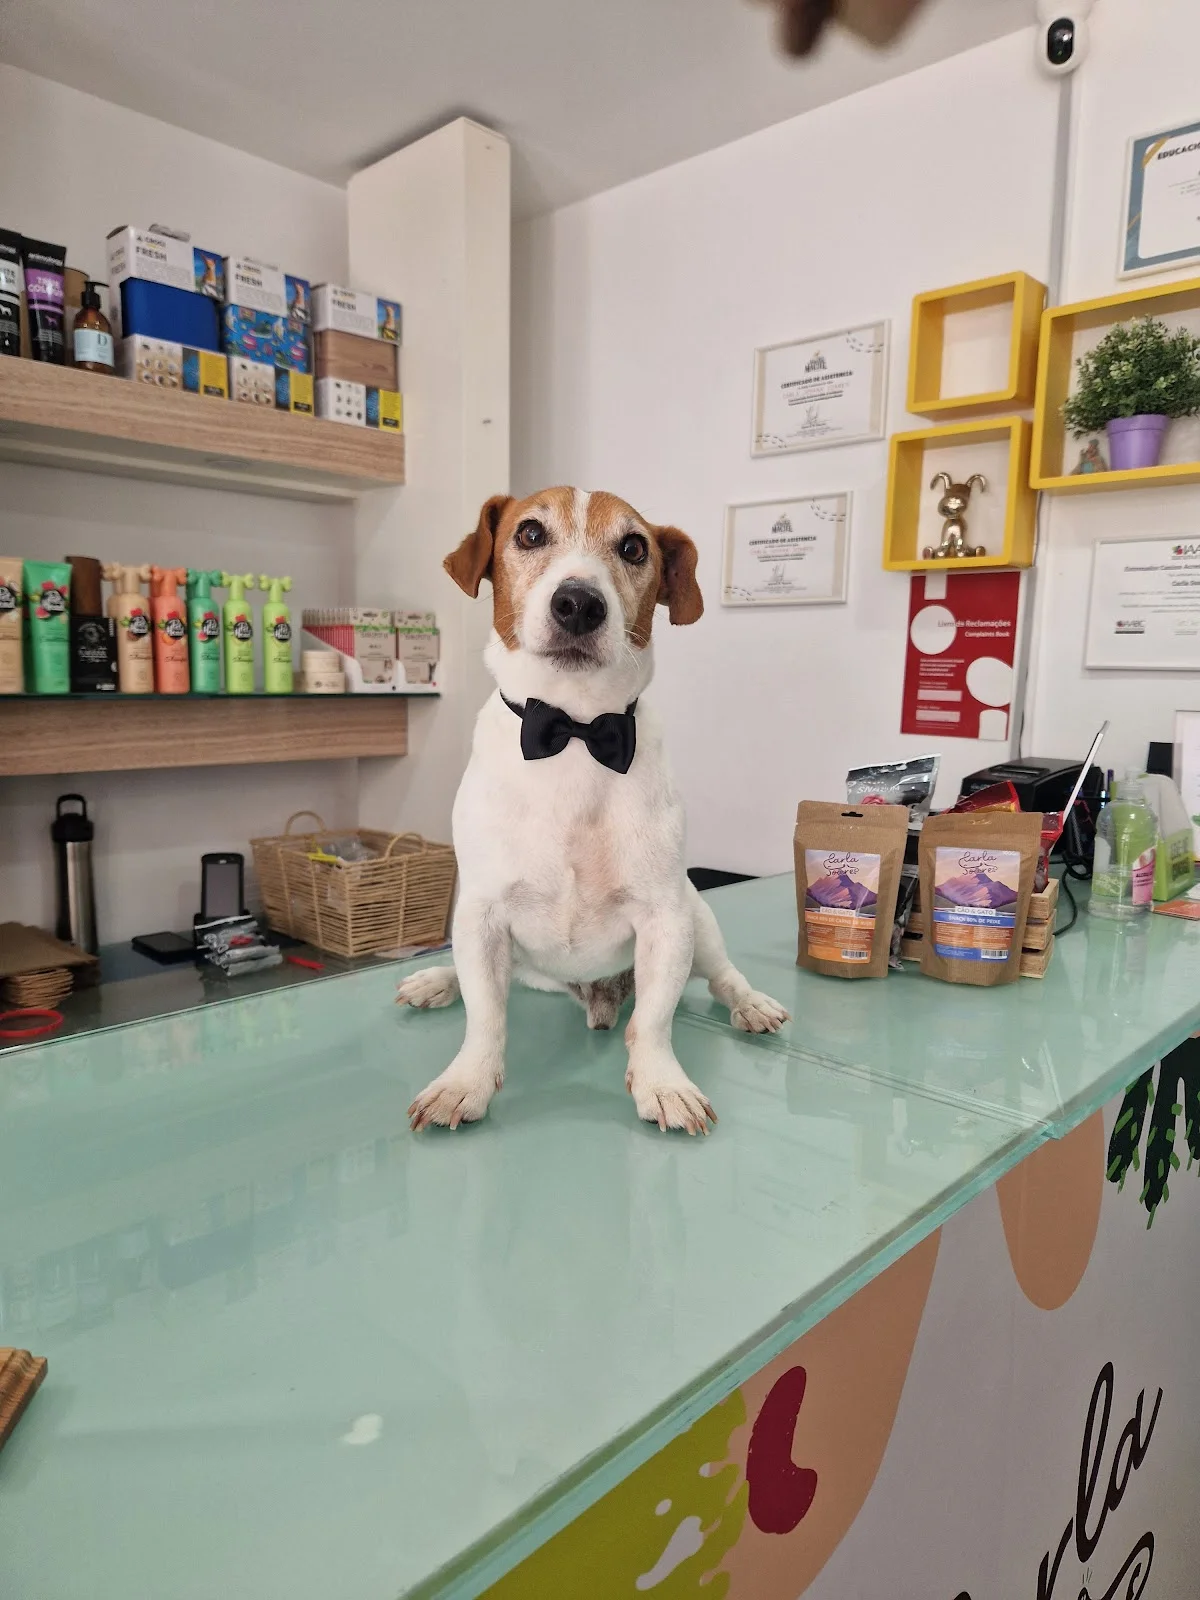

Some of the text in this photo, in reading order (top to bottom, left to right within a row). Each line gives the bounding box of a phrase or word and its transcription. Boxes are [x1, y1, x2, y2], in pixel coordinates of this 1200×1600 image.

[137, 247, 167, 262] FRESH
[956, 619, 965, 627] de
[966, 619, 1011, 629] Reclamações
[965, 630, 1010, 639] Complaints Book
